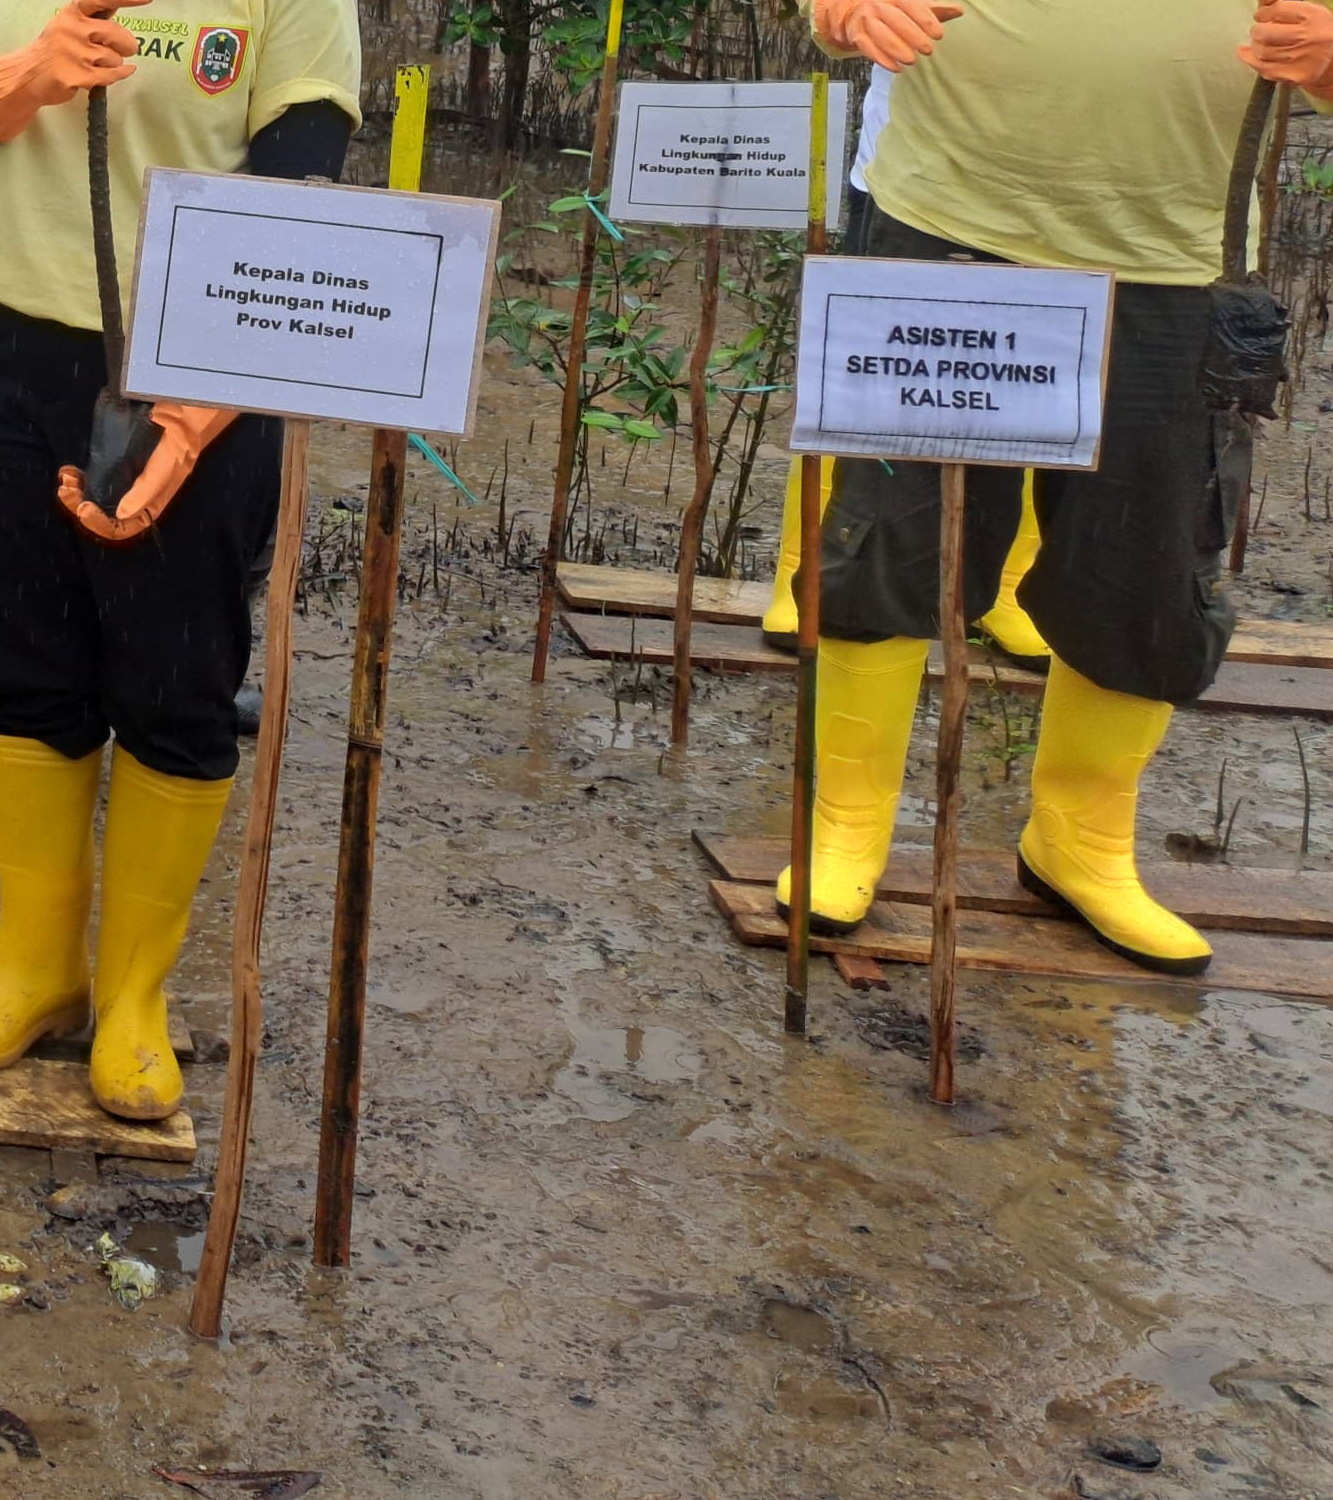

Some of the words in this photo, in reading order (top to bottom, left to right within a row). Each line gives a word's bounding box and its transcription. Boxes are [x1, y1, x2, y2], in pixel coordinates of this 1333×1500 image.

[132, 18, 190, 37] KALSEL
[679, 134, 729, 147] Kepala
[733, 134, 770, 145] Dinas
[746, 150, 786, 163] Hidup
[639, 163, 715, 178] Kabupaten
[719, 167, 762, 178] Barito
[766, 167, 806, 178] Kuala
[233, 261, 306, 283] Kepala
[311, 270, 370, 291] Dinas
[206, 283, 325, 311] Lingkungan
[331, 298, 392, 322] Hidup
[236, 312, 283, 331] Prov
[288, 318, 355, 340] Kalsel
[887, 325, 997, 349] ASISTEN
[1004, 331, 1017, 350] 1
[846, 355, 930, 378] SETDA
[936, 359, 1056, 385] PROVINSI
[900, 387, 1000, 411] KALSEL
